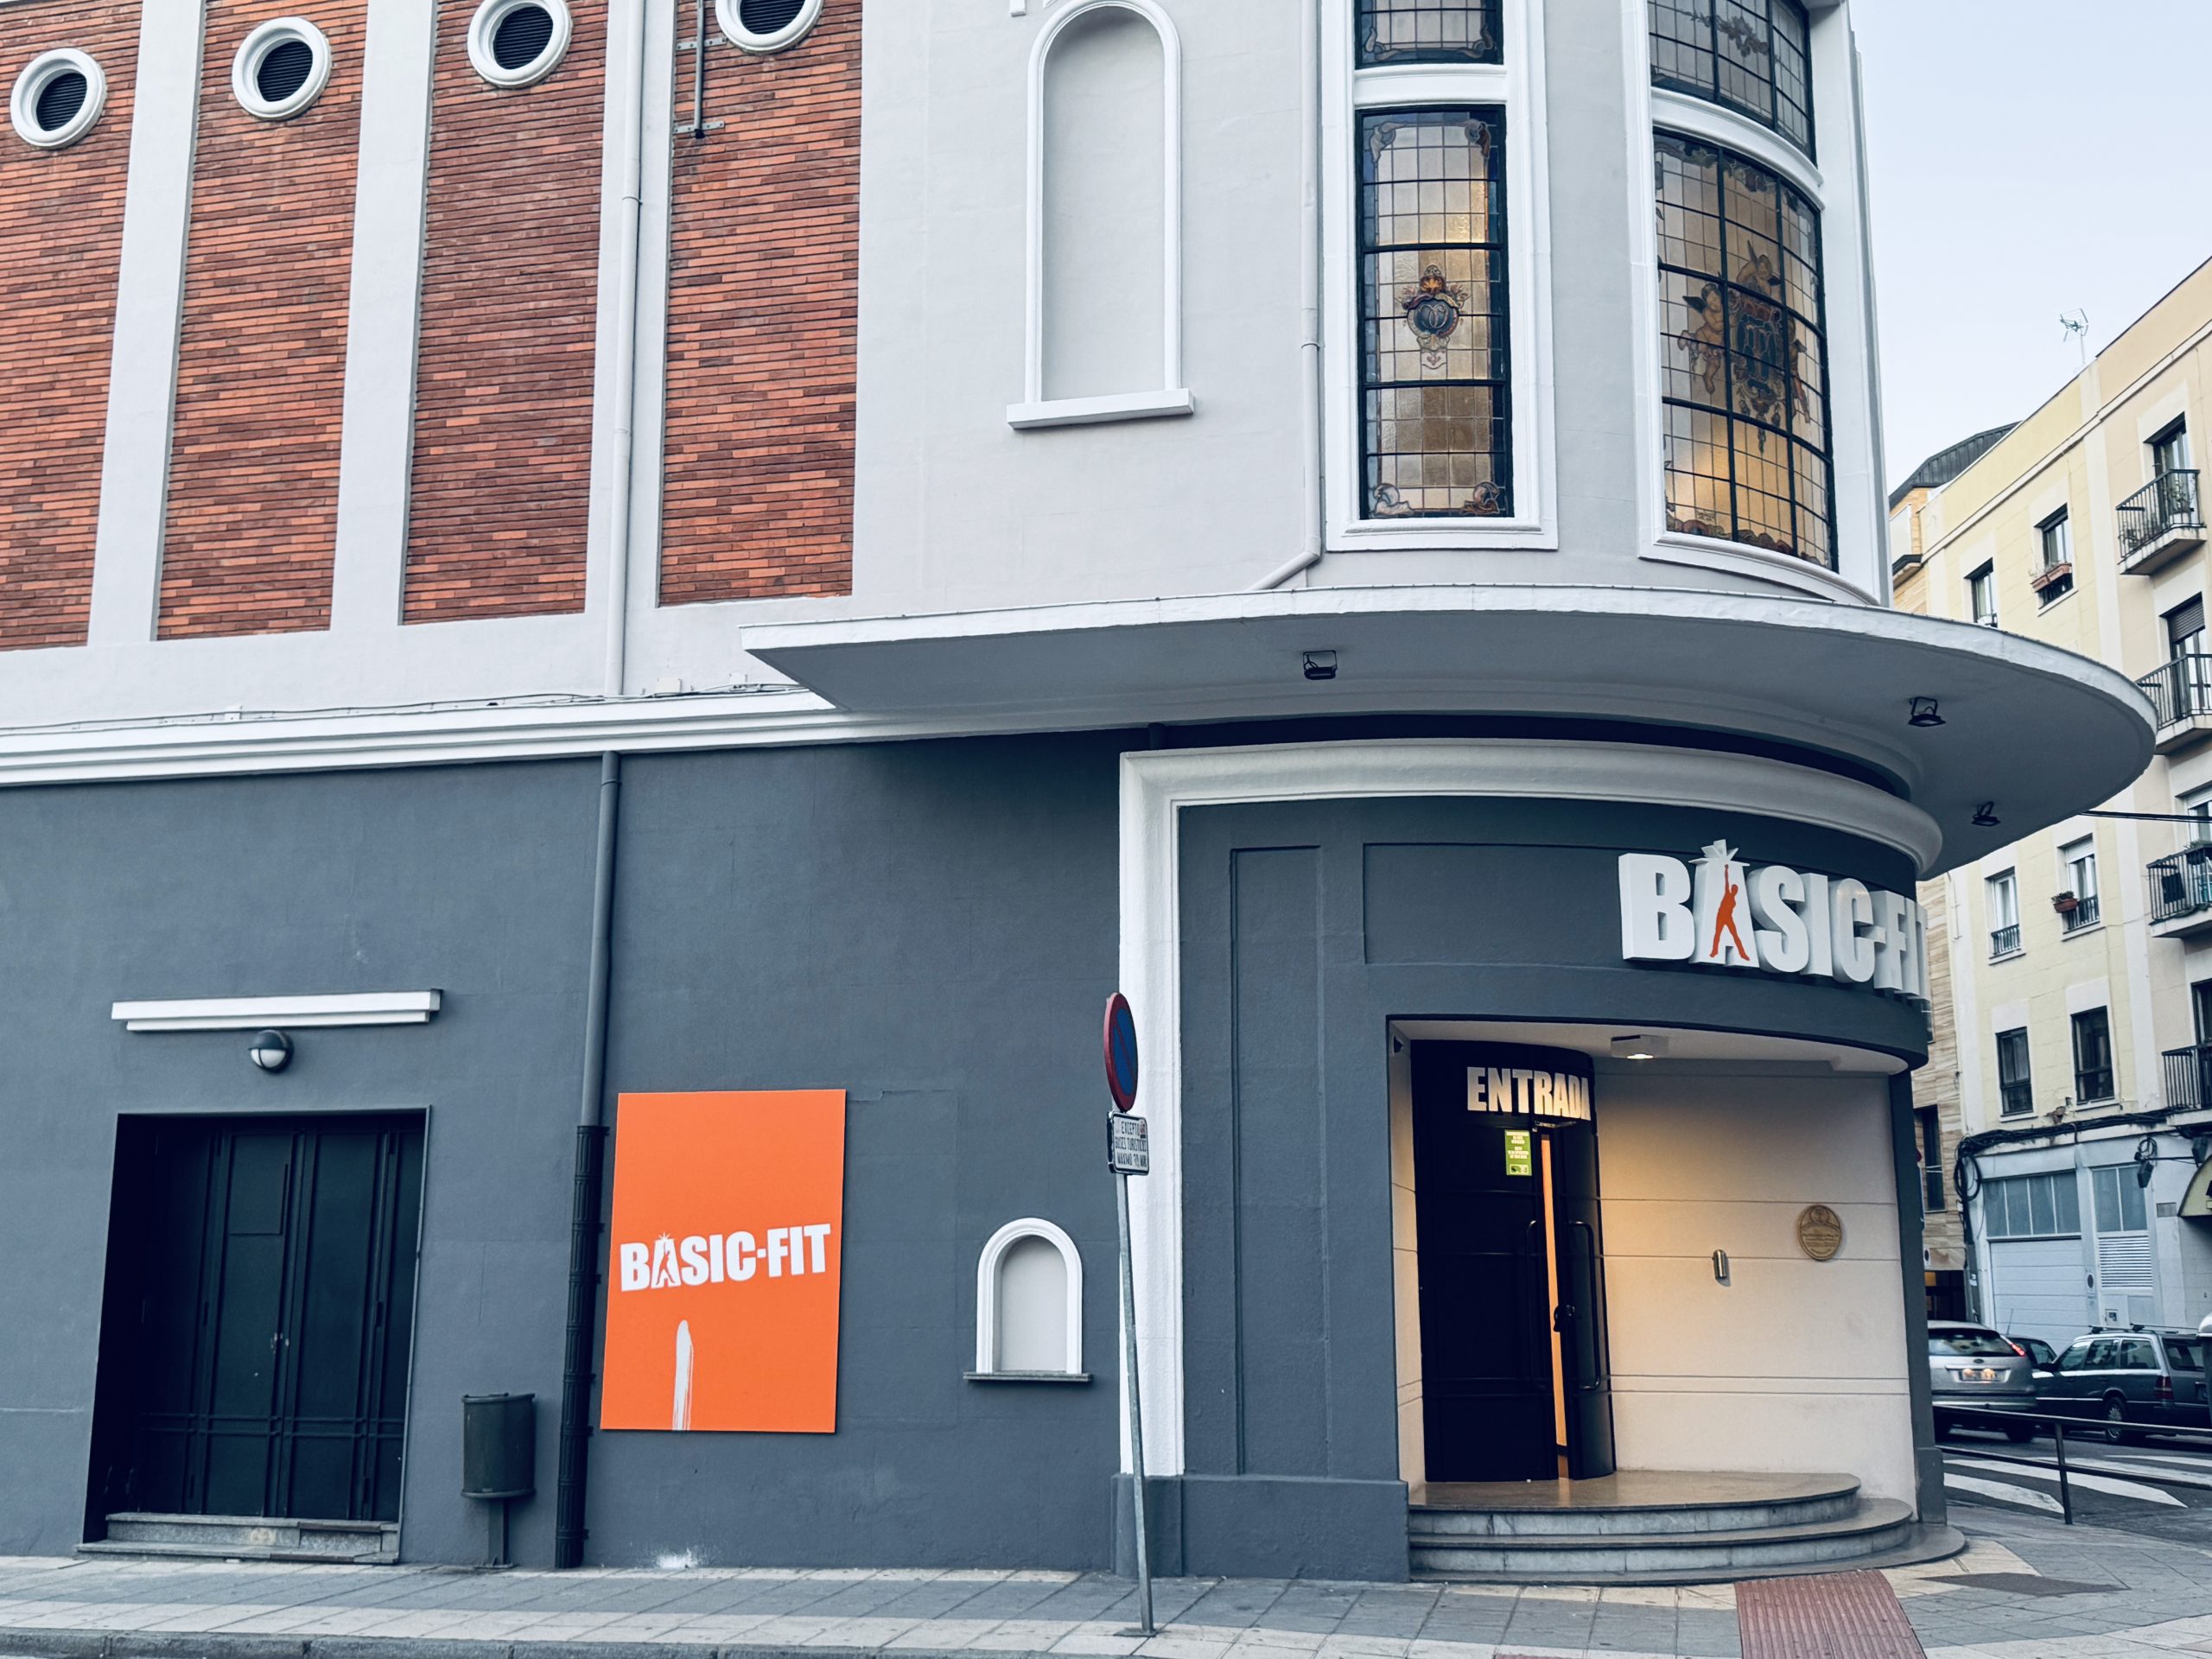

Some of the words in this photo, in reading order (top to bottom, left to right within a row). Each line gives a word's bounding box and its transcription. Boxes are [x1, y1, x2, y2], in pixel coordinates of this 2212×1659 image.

[1618, 841, 1931, 1001] BASIC-FIT
[1467, 1067, 1592, 1121] ENTRADA
[620, 1224, 831, 1292] BASIC-FIT
